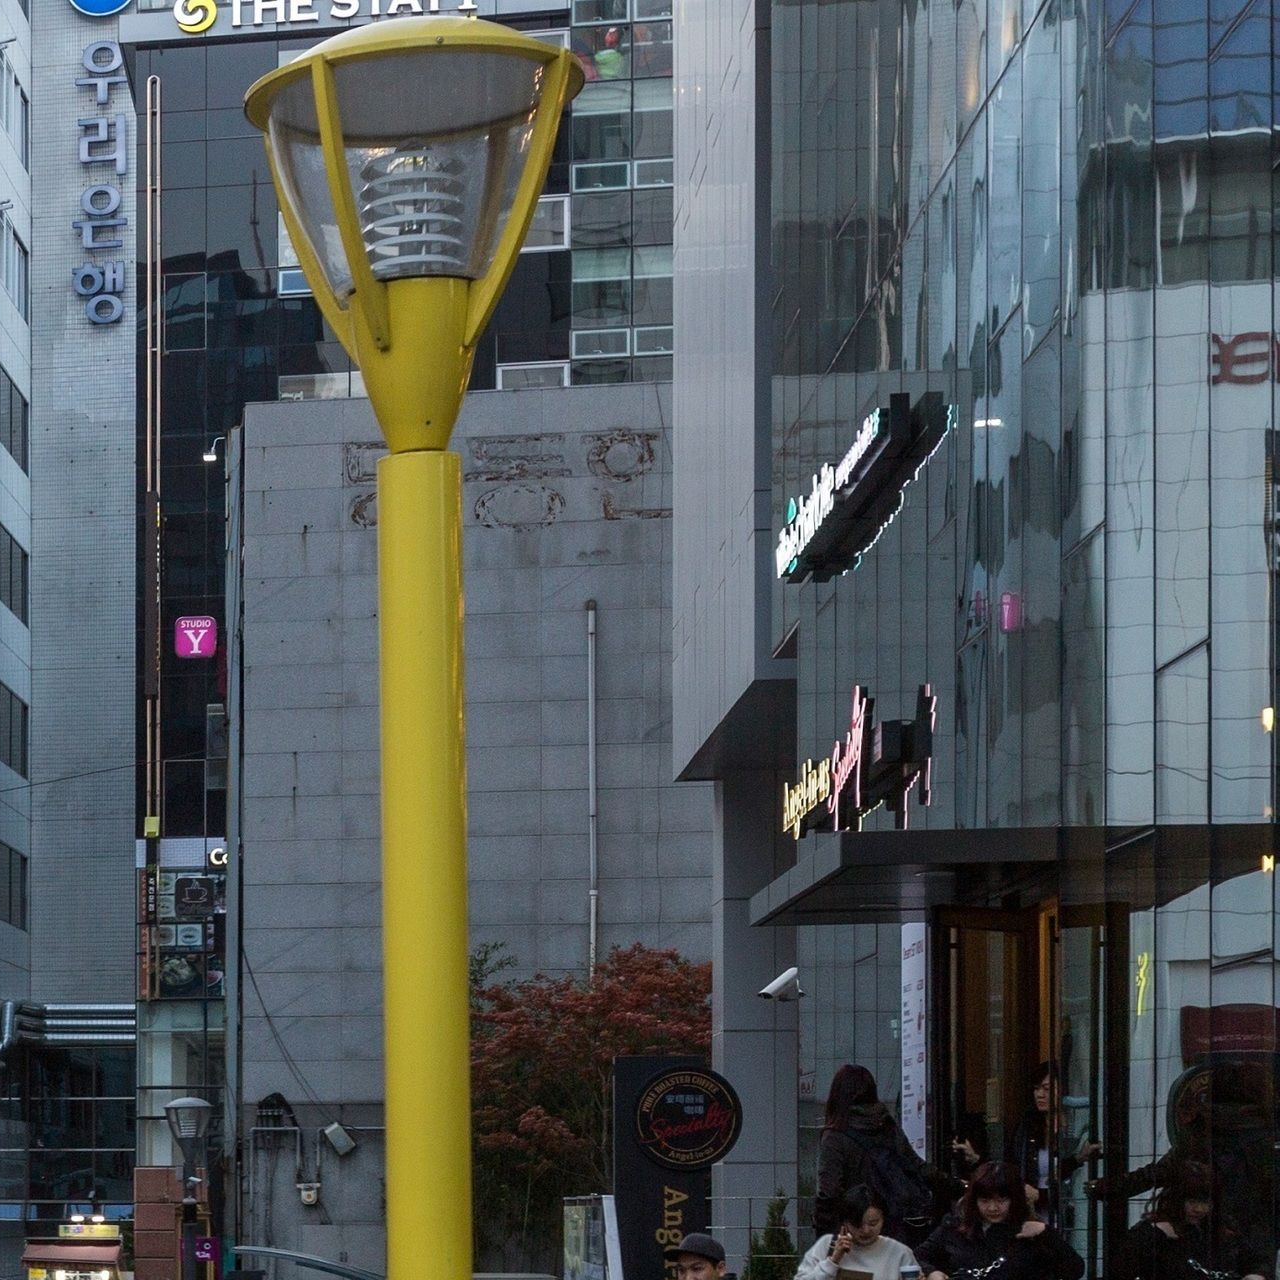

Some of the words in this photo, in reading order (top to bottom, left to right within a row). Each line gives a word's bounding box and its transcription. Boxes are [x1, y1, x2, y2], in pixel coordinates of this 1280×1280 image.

[73, 41, 128, 324] 우리은행
[180, 619, 211, 628] STUDIO
[184, 630, 208, 654] Y
